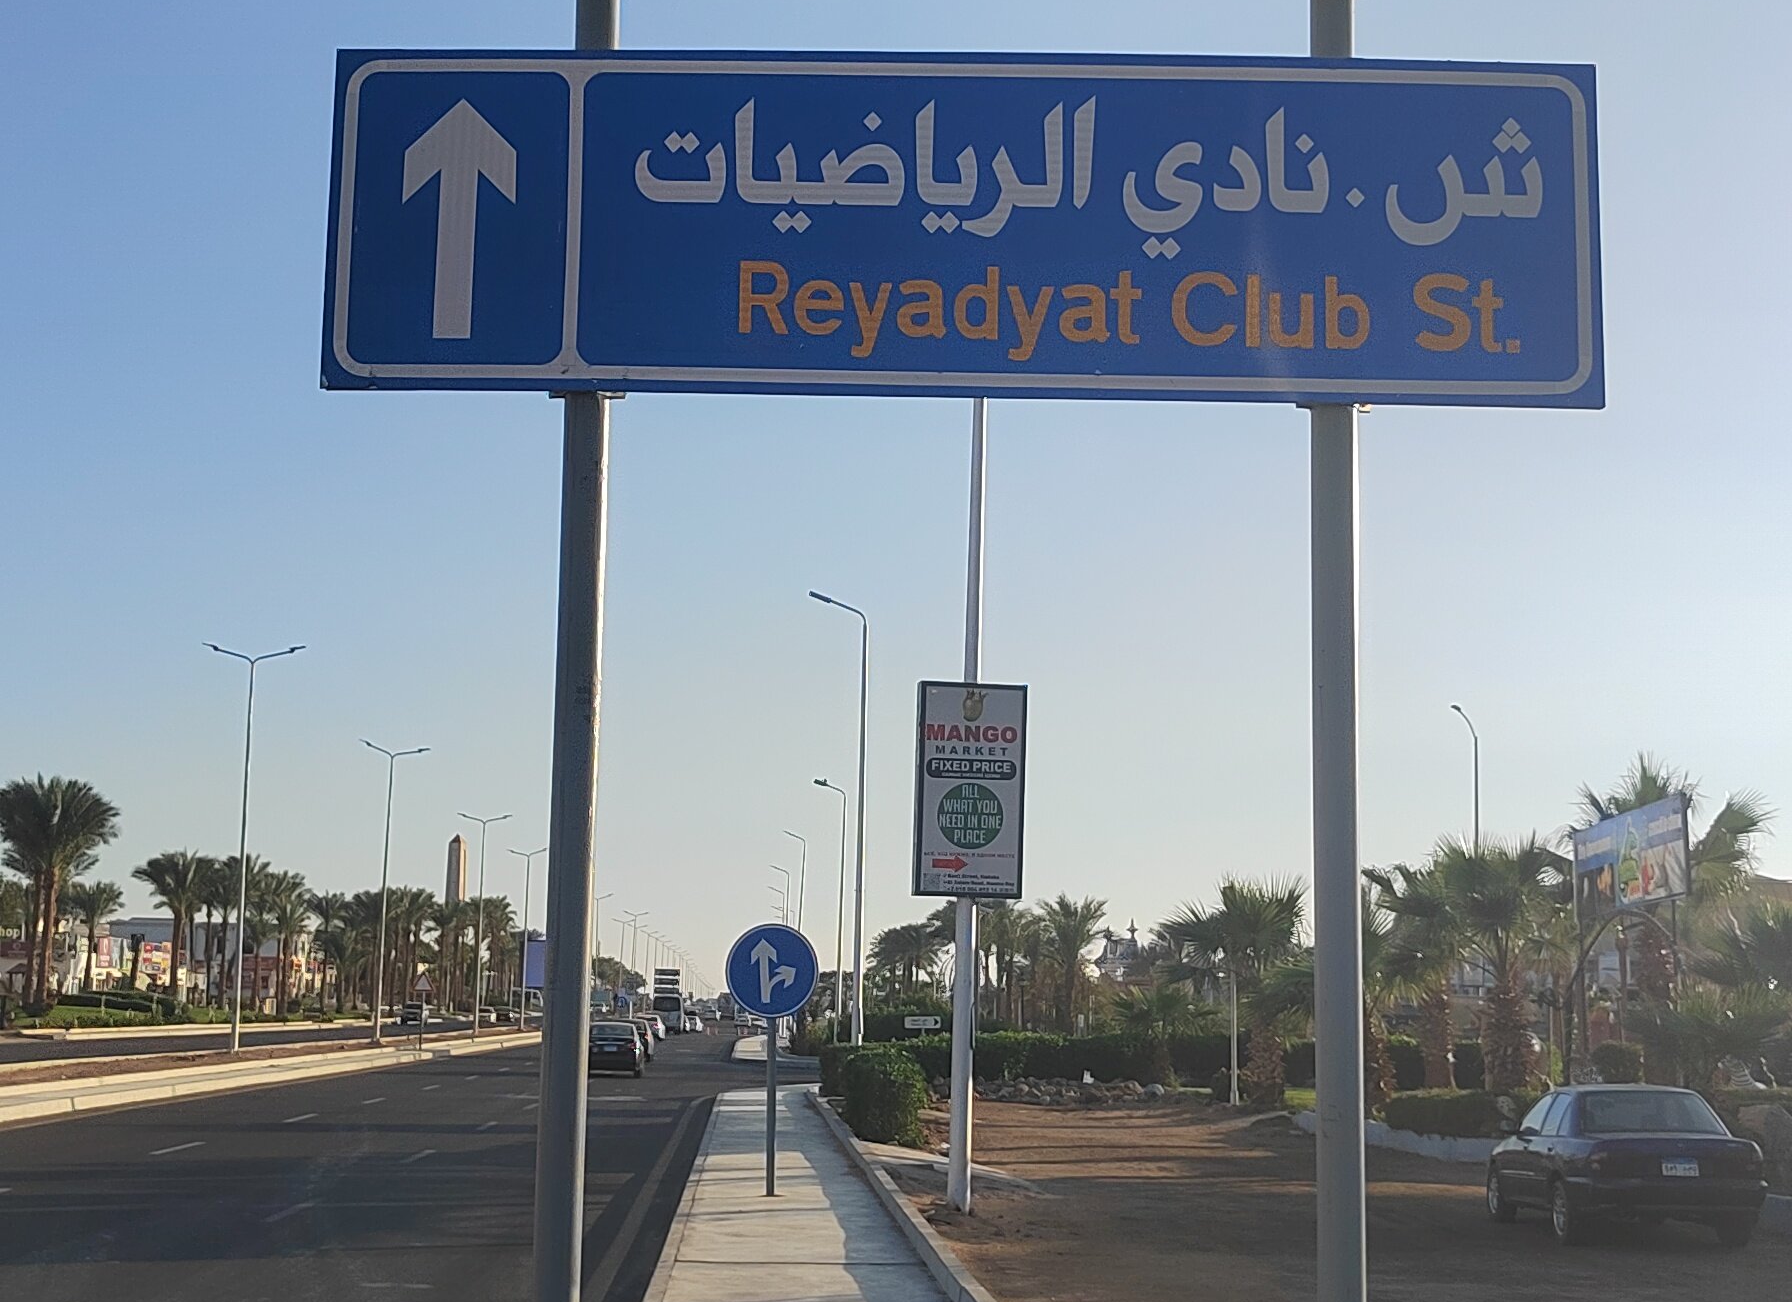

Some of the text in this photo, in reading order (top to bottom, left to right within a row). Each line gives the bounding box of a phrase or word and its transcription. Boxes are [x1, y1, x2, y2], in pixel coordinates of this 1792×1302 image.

[633, 95, 1098, 240] الرياضيات
[1120, 106, 1332, 260] نادي
[735, 258, 1523, 364] Reyadyat Club St.
[926, 724, 1018, 744] MANGO
[935, 745, 1008, 756] MARKET
[931, 760, 1012, 773] FIXED PRICE
[962, 784, 980, 798] ALL
[943, 799, 998, 814] WHAT YOU
[939, 814, 1002, 829] NEED IN ONE
[954, 829, 986, 844] PLACE
